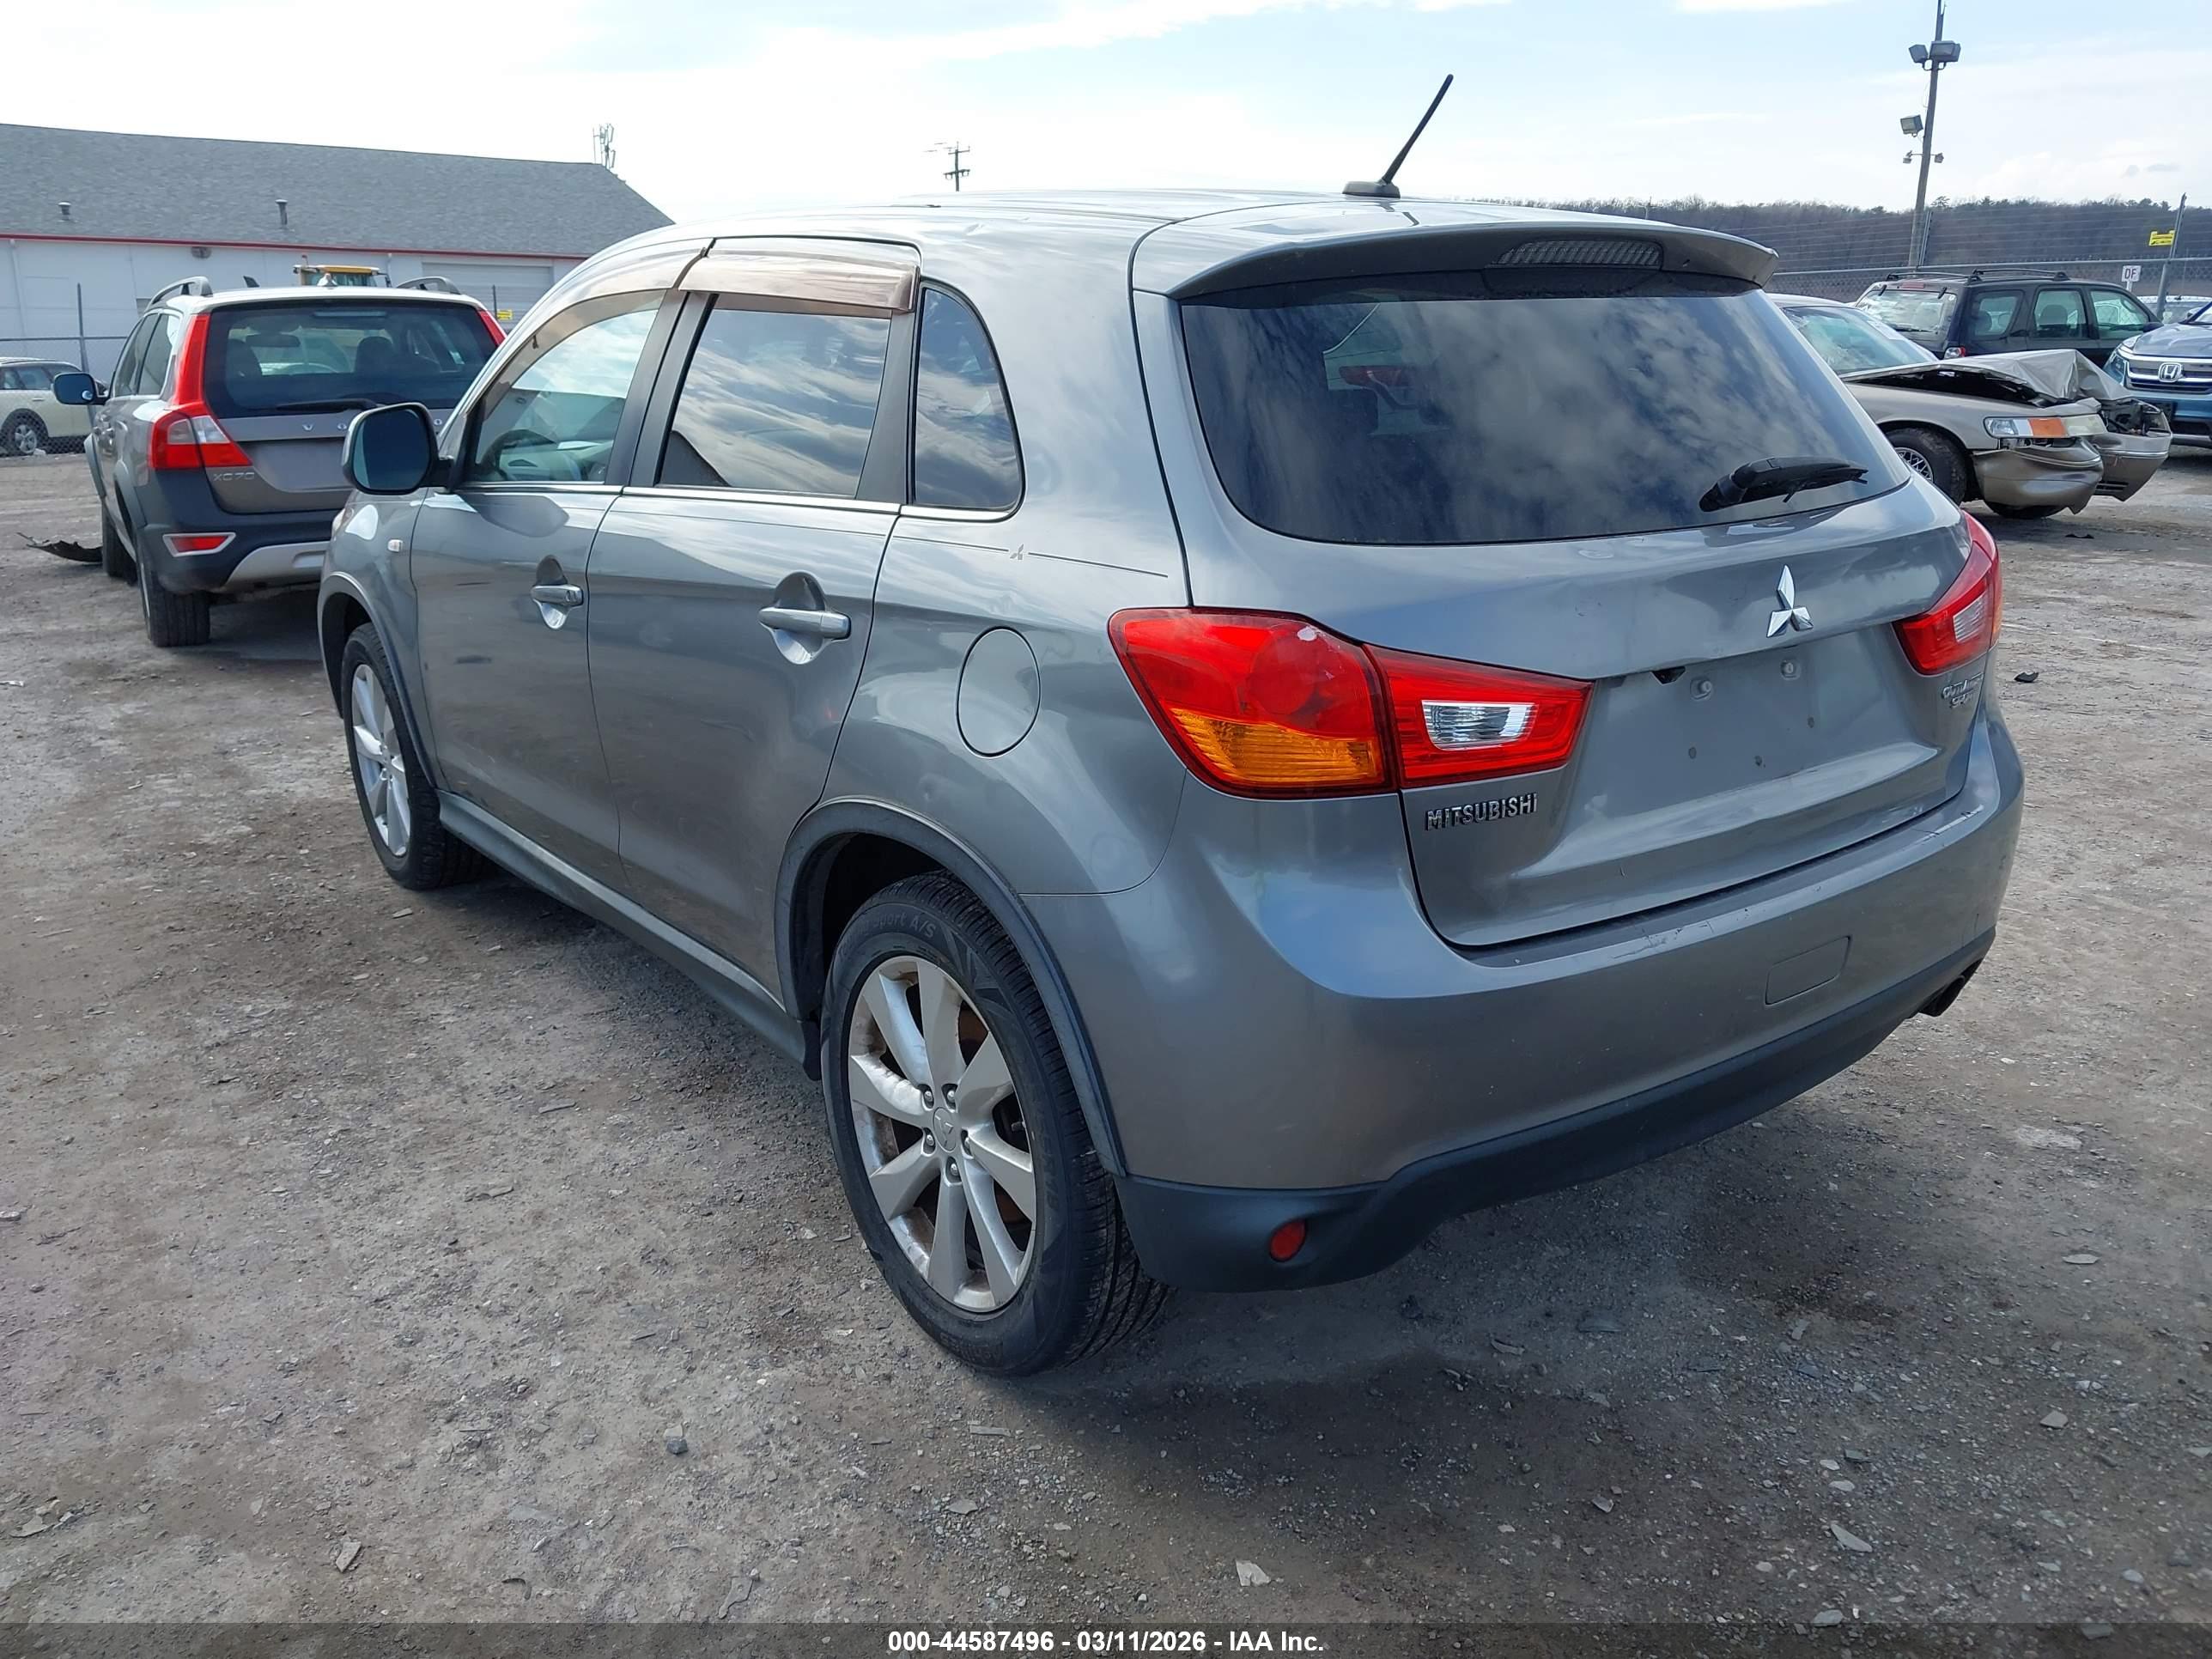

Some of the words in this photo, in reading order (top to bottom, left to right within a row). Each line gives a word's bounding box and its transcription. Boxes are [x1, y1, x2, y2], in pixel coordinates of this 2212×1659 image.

[2124, 268, 2137, 279] DF
[301, 418, 442, 432] VOO
[213, 471, 255, 482] XC70
[1425, 792, 1538, 831] MITSUBISHI
[909, 915, 936, 938] A/S
